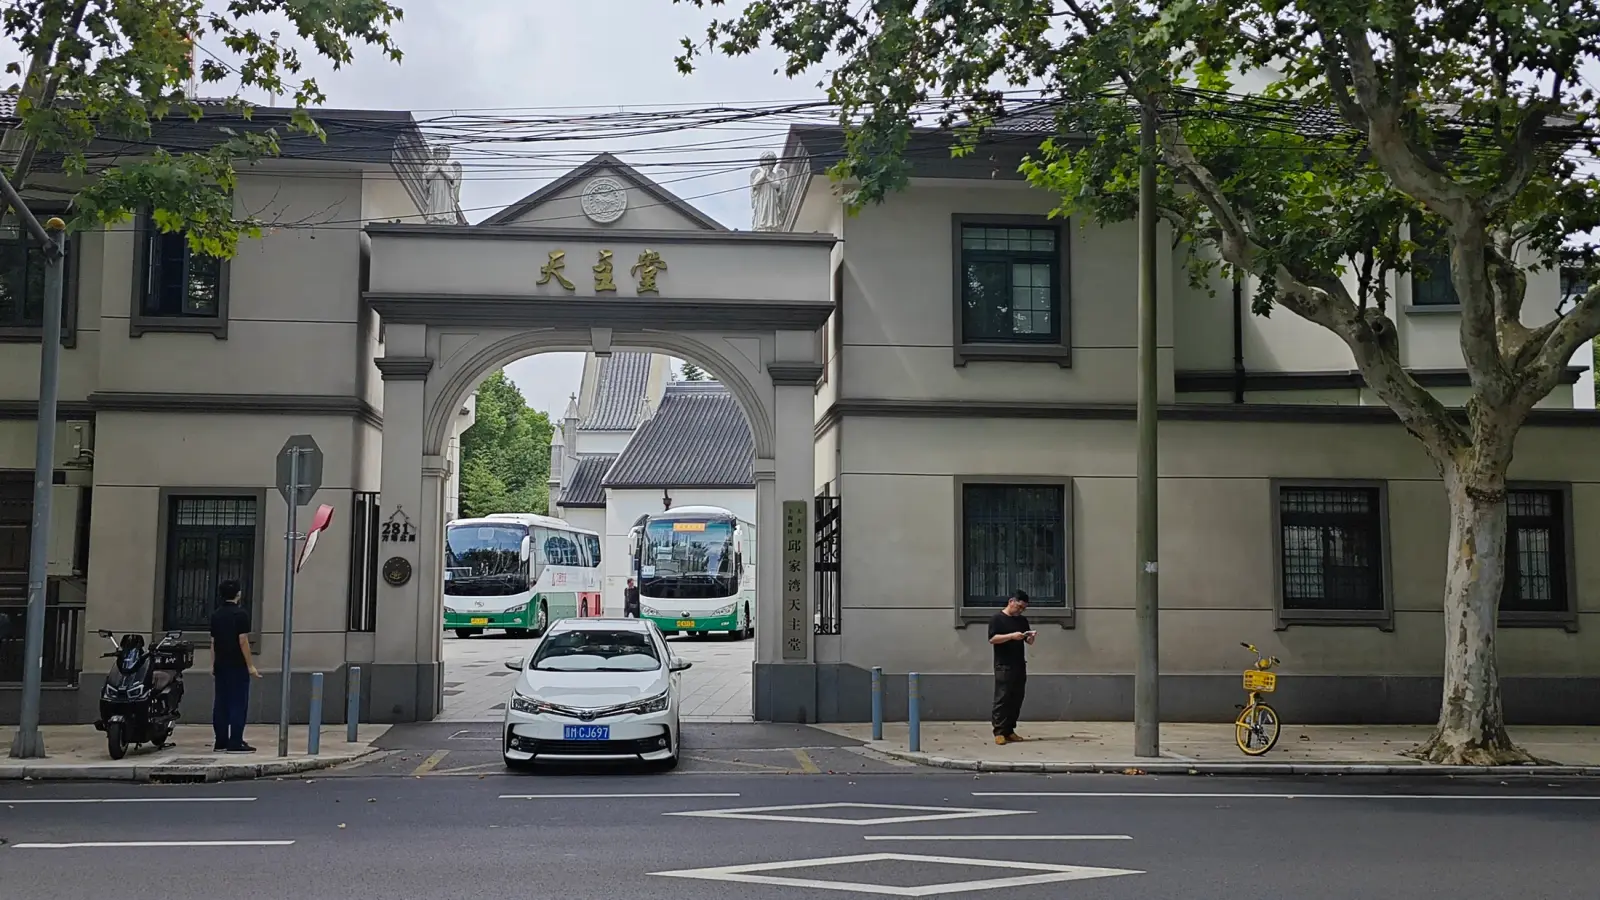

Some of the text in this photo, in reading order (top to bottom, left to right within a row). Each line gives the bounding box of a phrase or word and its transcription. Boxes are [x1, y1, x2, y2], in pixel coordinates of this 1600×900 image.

[536, 248, 667, 293] 天主堂
[381, 522, 409, 535] 281
[788, 539, 801, 652] 邱家湾天主堂
[566, 727, 608, 738] M·CJ697
